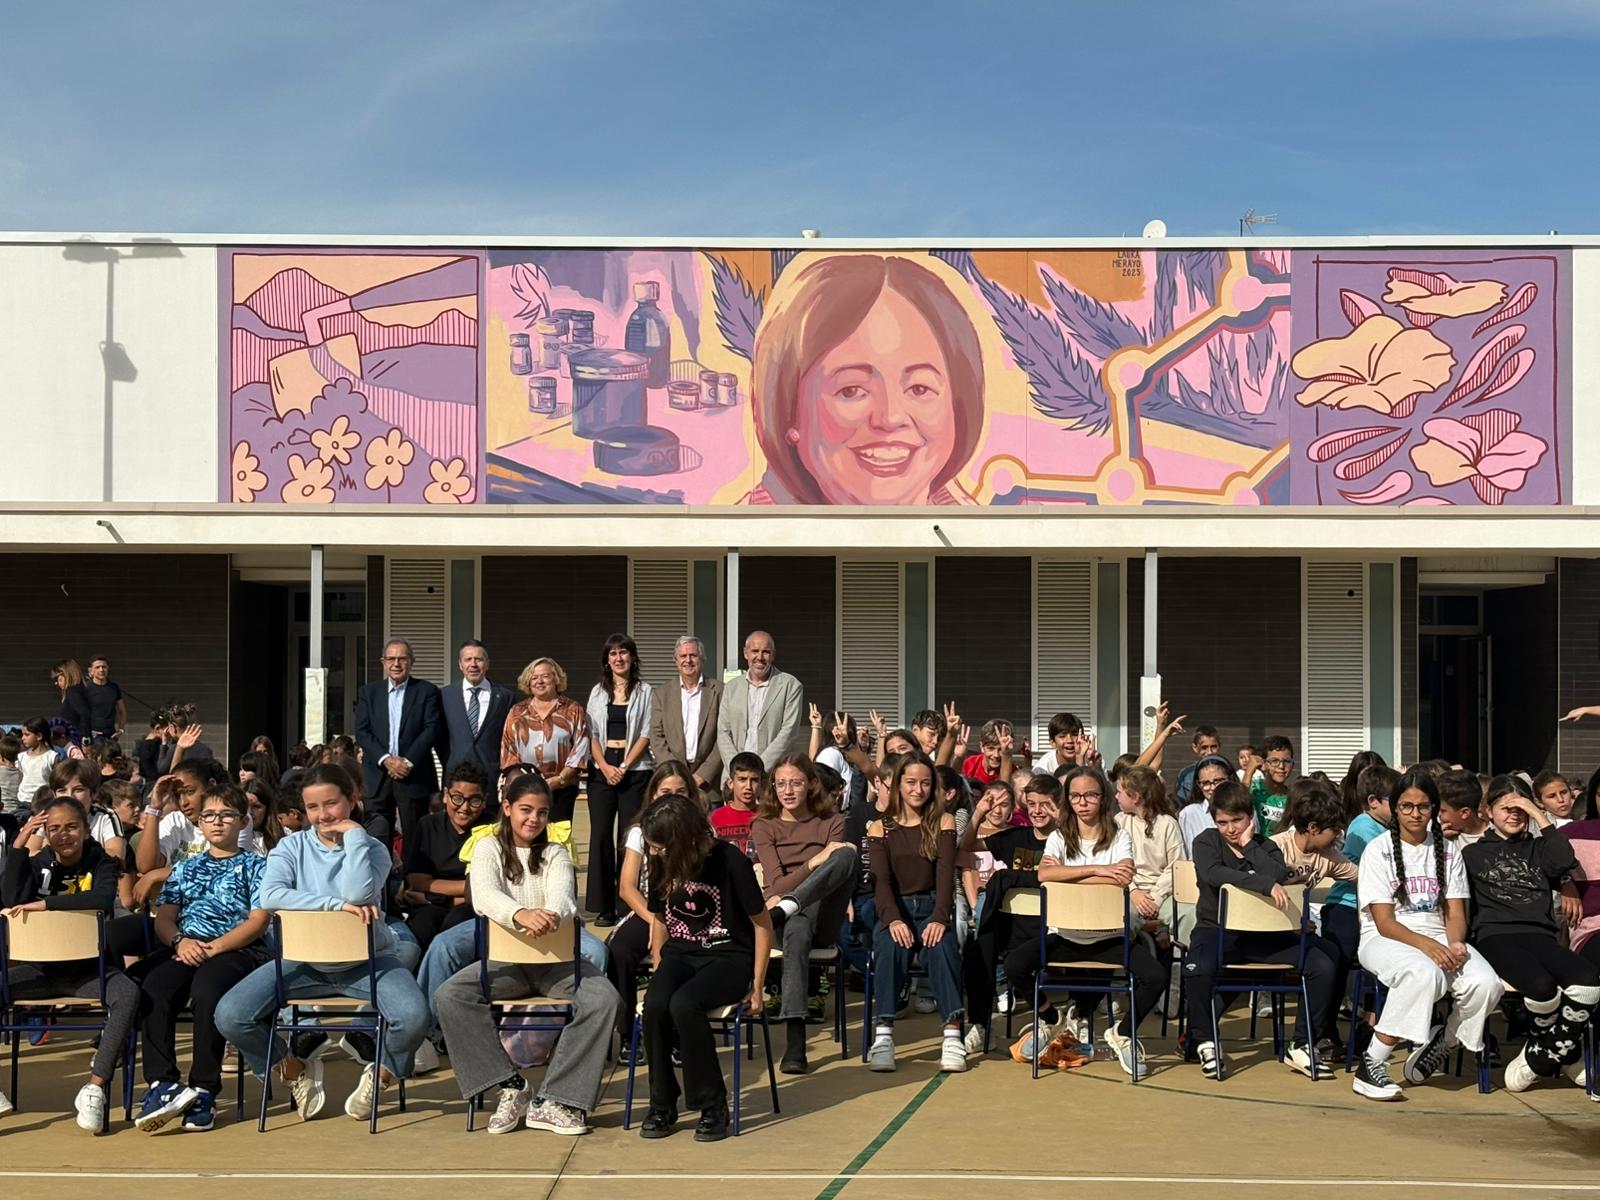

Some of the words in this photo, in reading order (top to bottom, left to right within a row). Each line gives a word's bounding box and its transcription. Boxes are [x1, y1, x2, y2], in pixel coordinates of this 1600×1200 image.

[1117, 249, 1141, 259] LAURA
[1112, 259, 1142, 268] MERAYO
[1122, 268, 1141, 277] 2025
[1389, 875, 1441, 895] SITC
